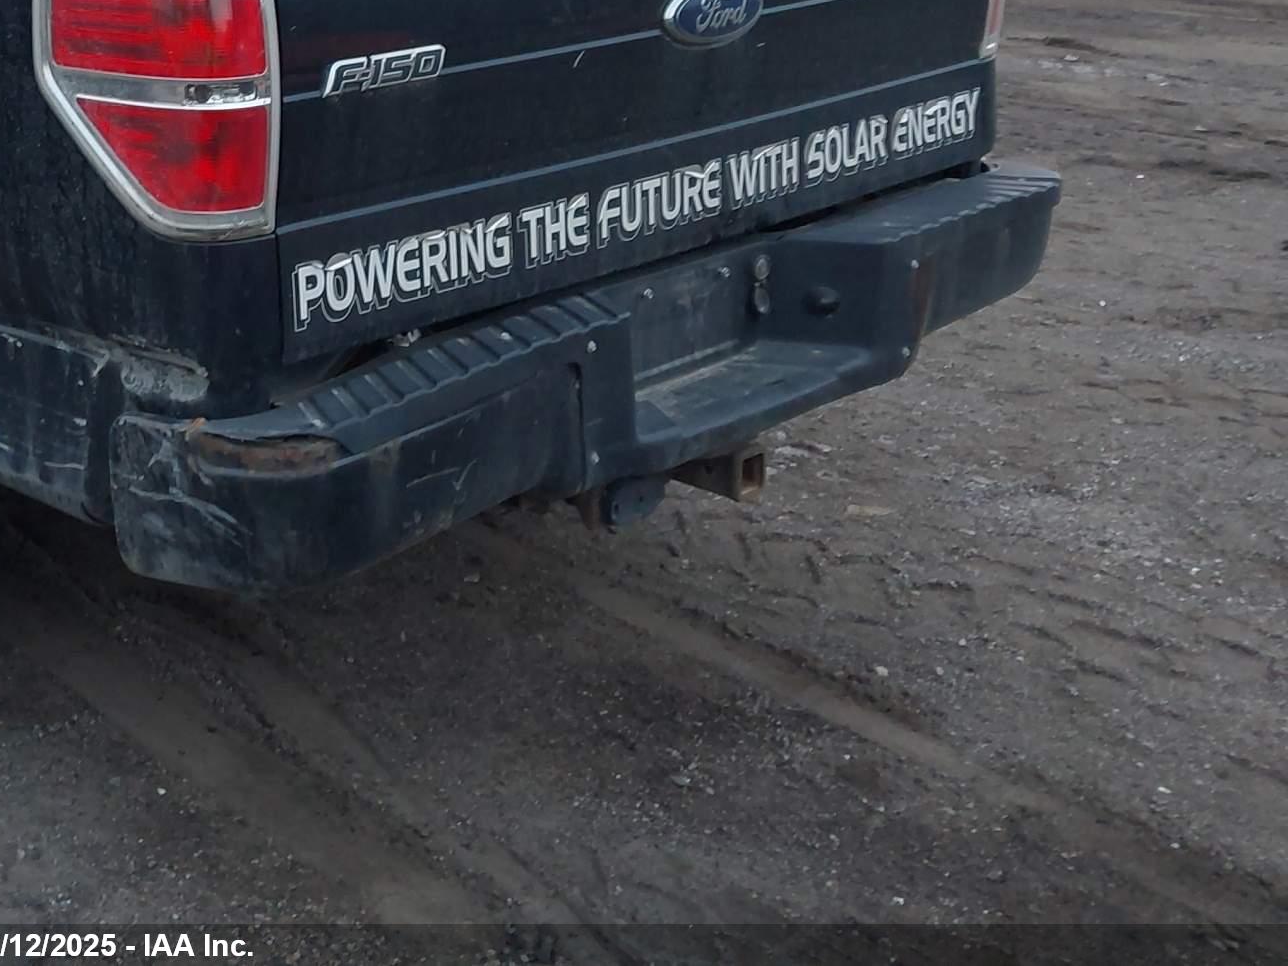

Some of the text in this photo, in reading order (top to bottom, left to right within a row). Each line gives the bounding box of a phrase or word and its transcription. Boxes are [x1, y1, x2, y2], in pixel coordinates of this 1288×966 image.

[292, 87, 981, 332] POWERING THE FUTURE WITH SOLAR ENERGY
